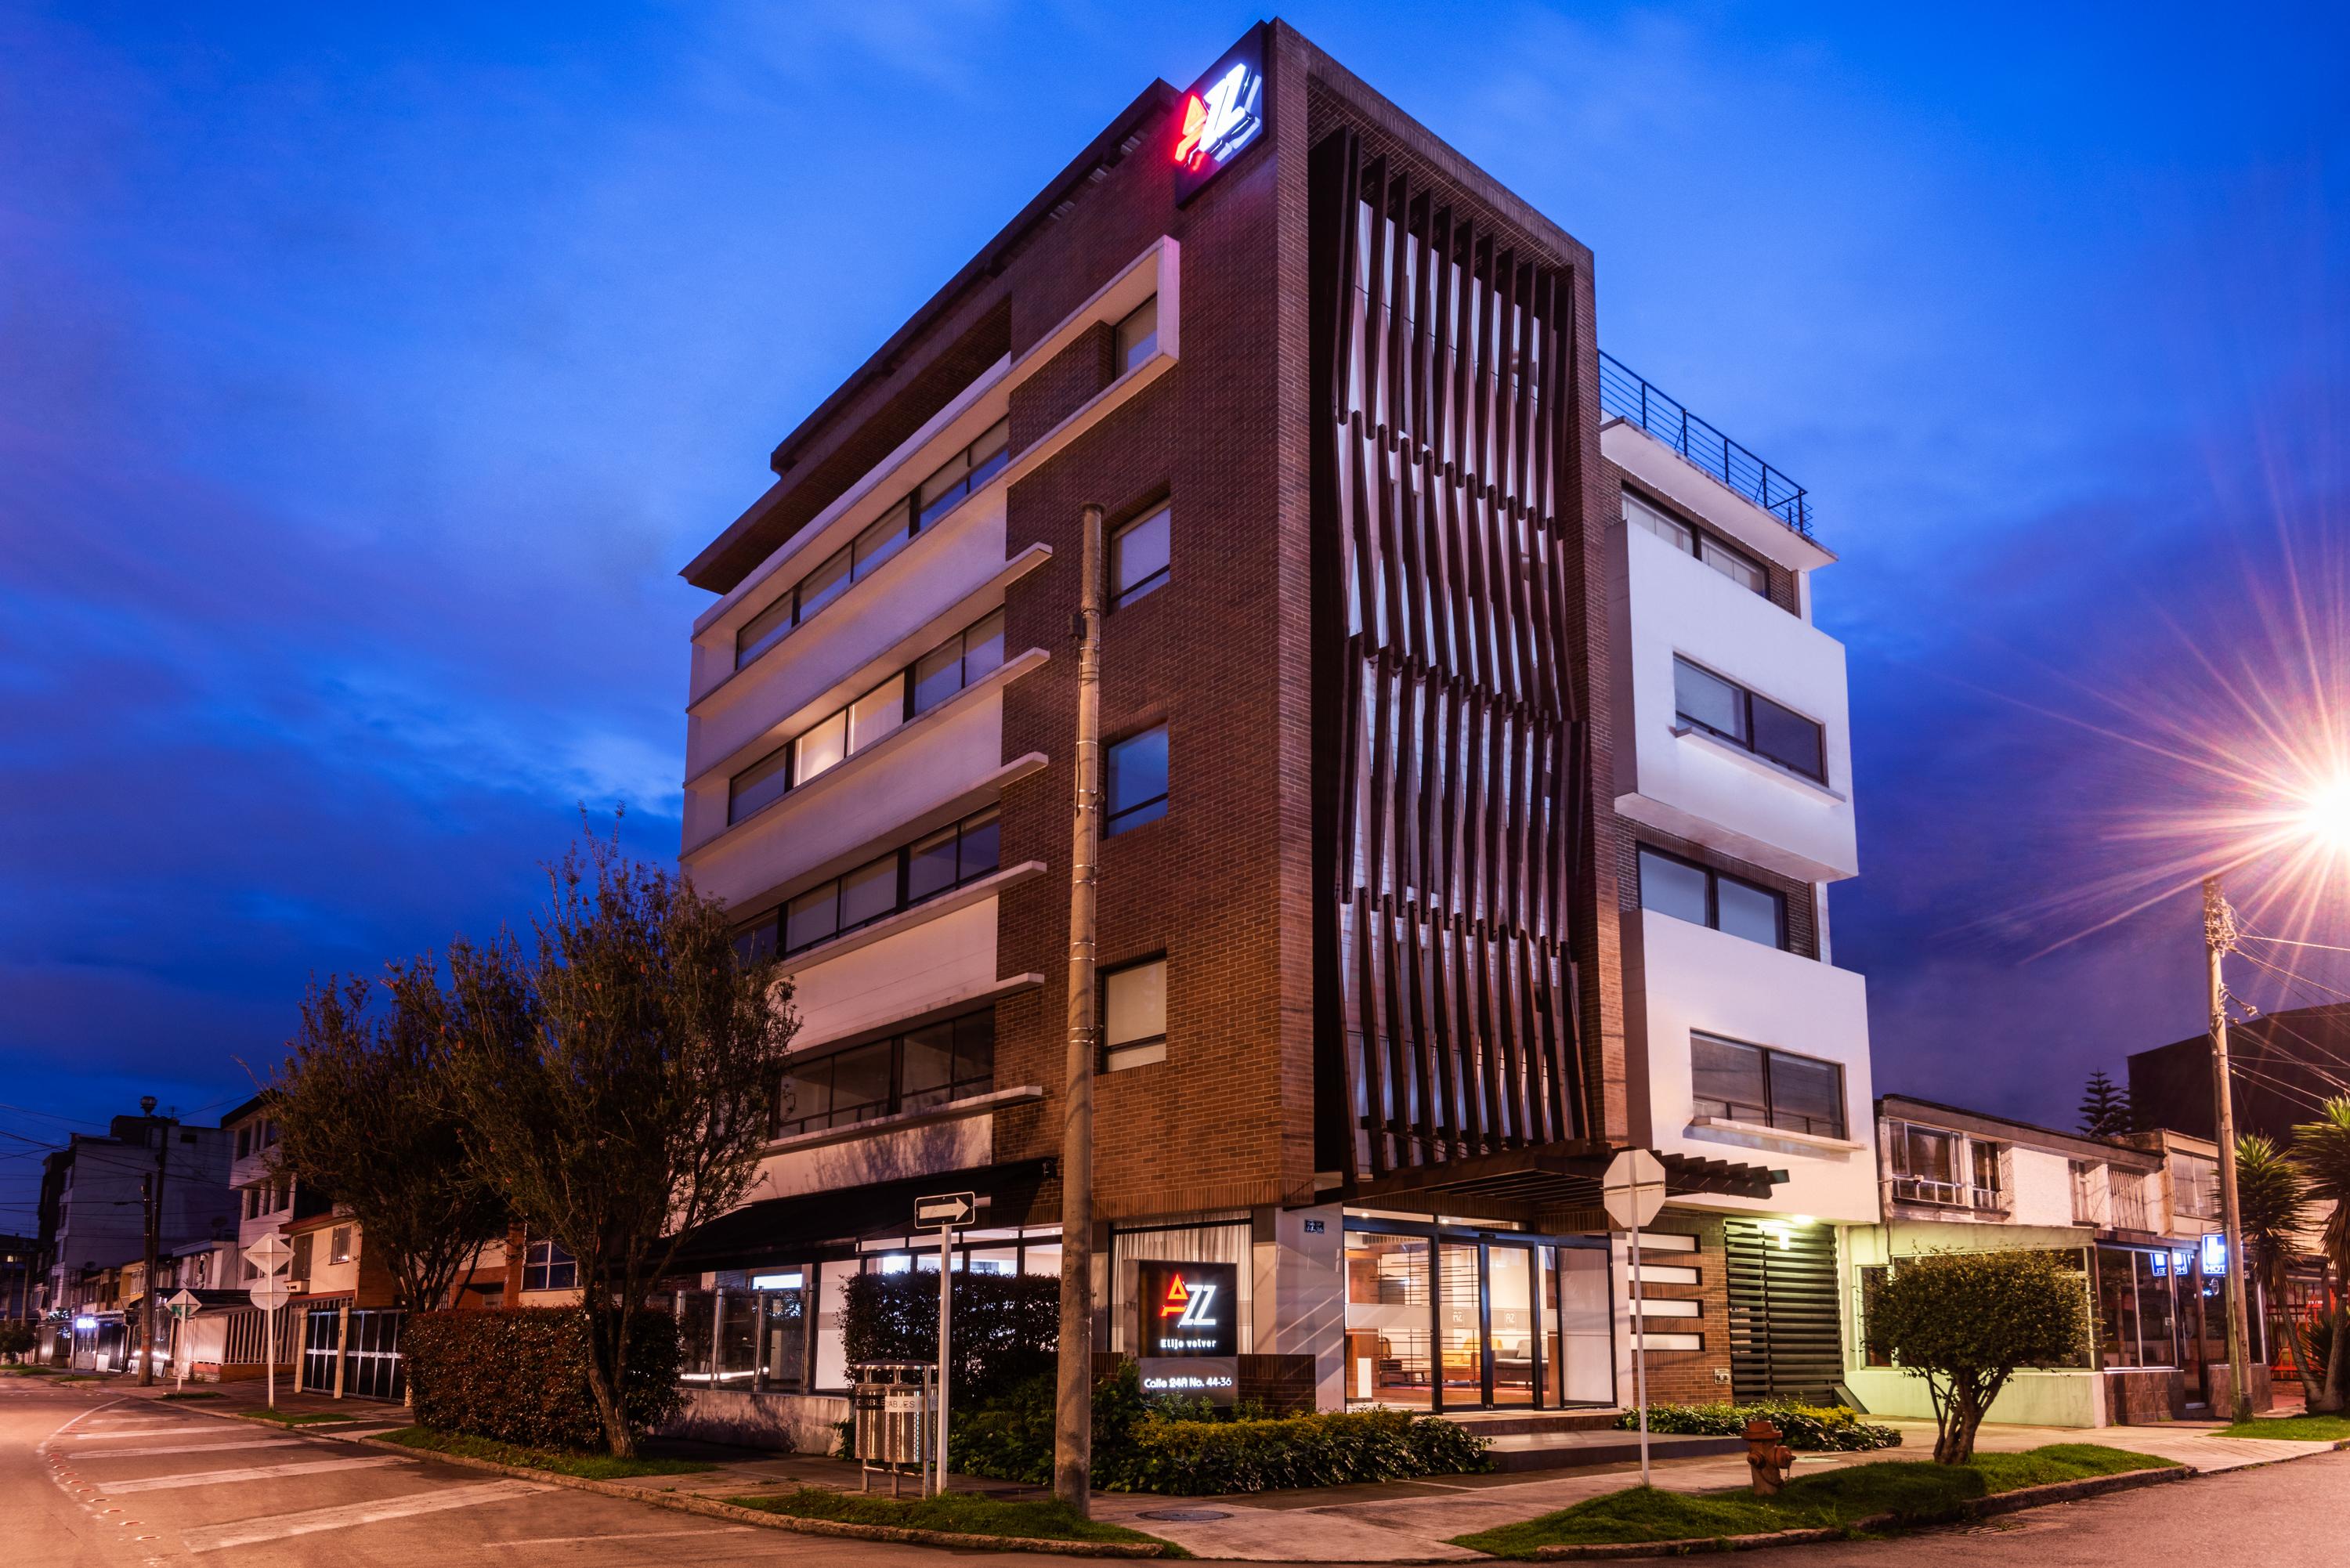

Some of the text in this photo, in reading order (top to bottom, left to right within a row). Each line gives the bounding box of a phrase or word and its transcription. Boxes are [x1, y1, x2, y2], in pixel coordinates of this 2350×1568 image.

[1144, 1378, 1167, 1389] Calle
[1189, 1377, 1205, 1387] No.
[1206, 1376, 1232, 1387] 44-36
